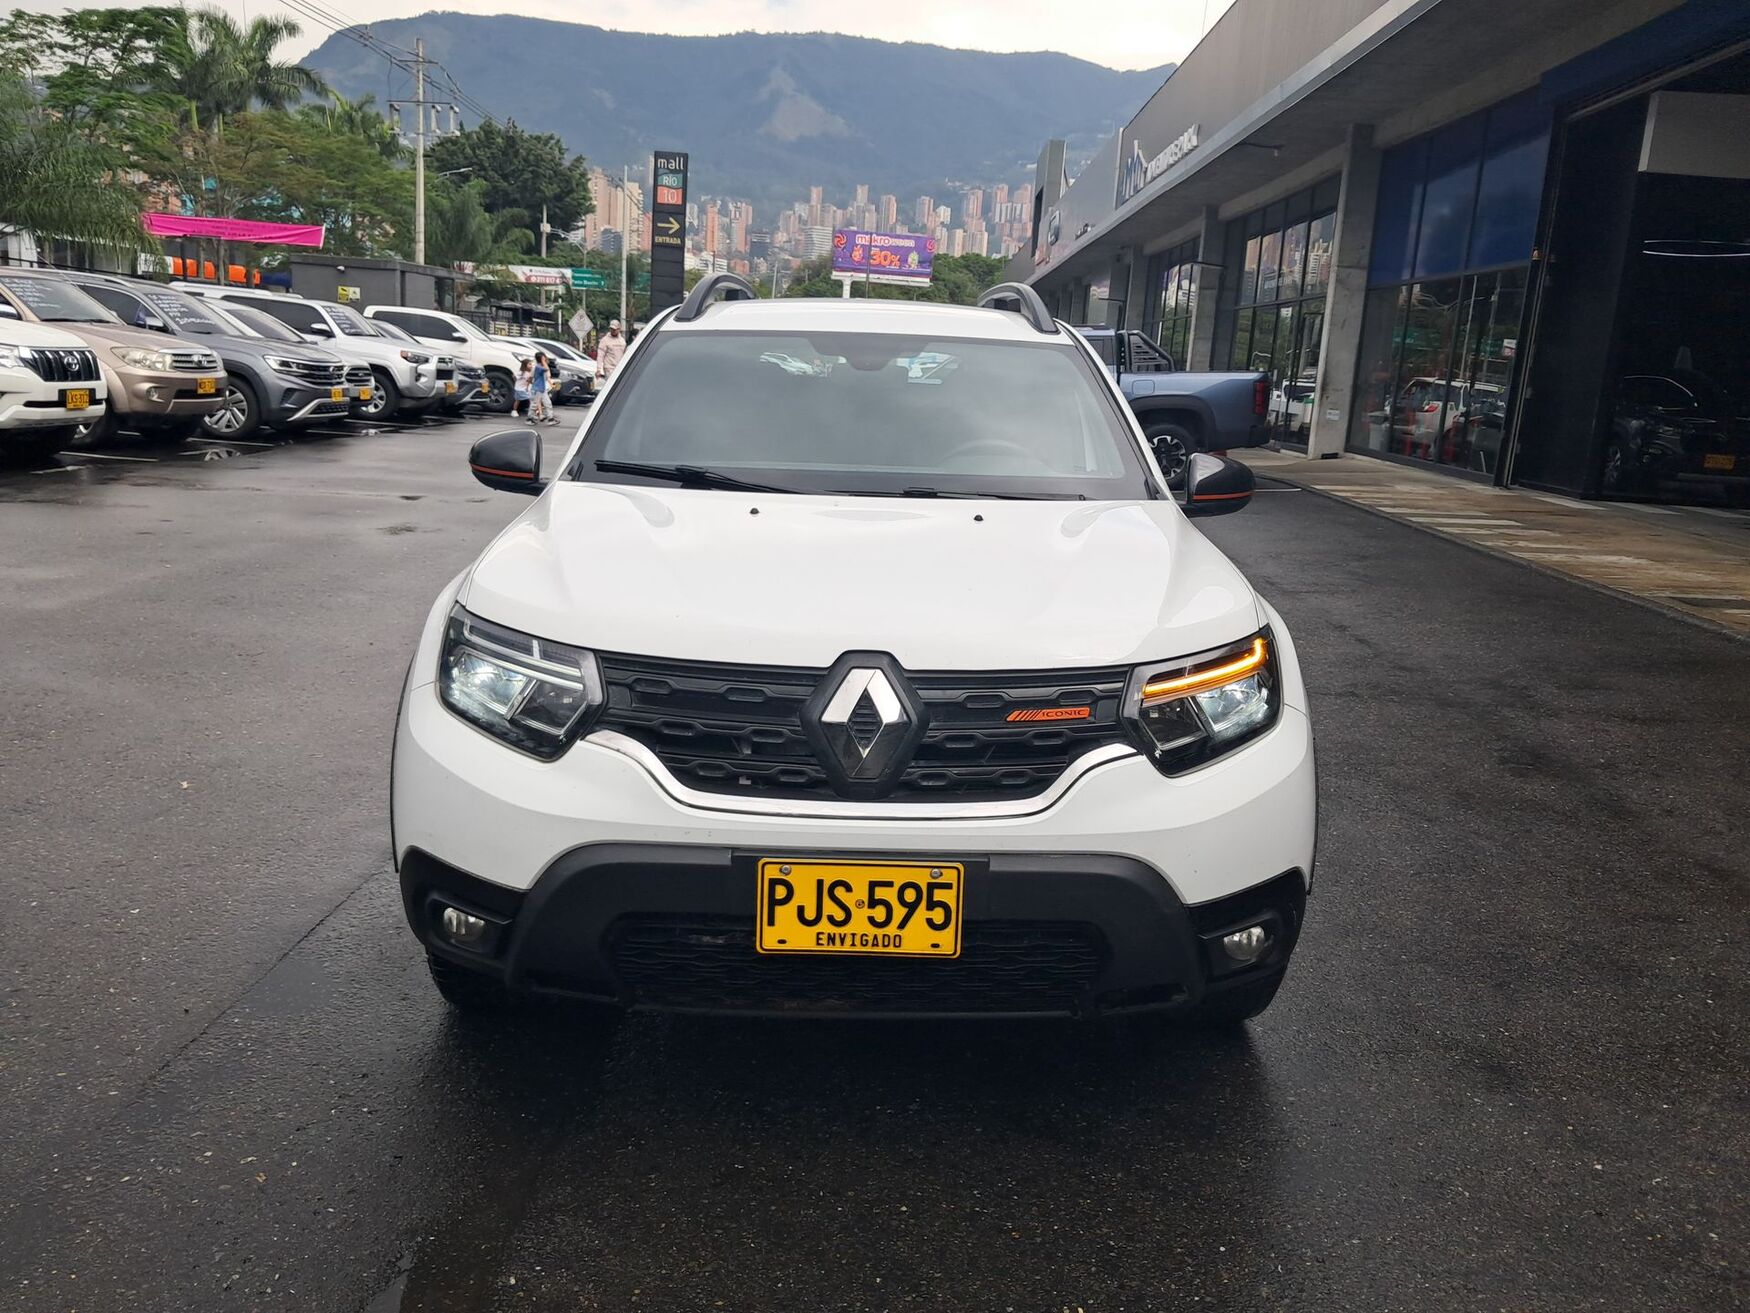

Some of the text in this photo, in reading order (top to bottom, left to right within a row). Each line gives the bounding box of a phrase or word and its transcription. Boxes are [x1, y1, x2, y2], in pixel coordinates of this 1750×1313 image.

[657, 157, 684, 170] mall
[664, 189, 678, 203] 10
[655, 236, 682, 245] ENTRADA
[1042, 710, 1085, 718] ICONIC
[816, 932, 903, 948] ENVIGADO
